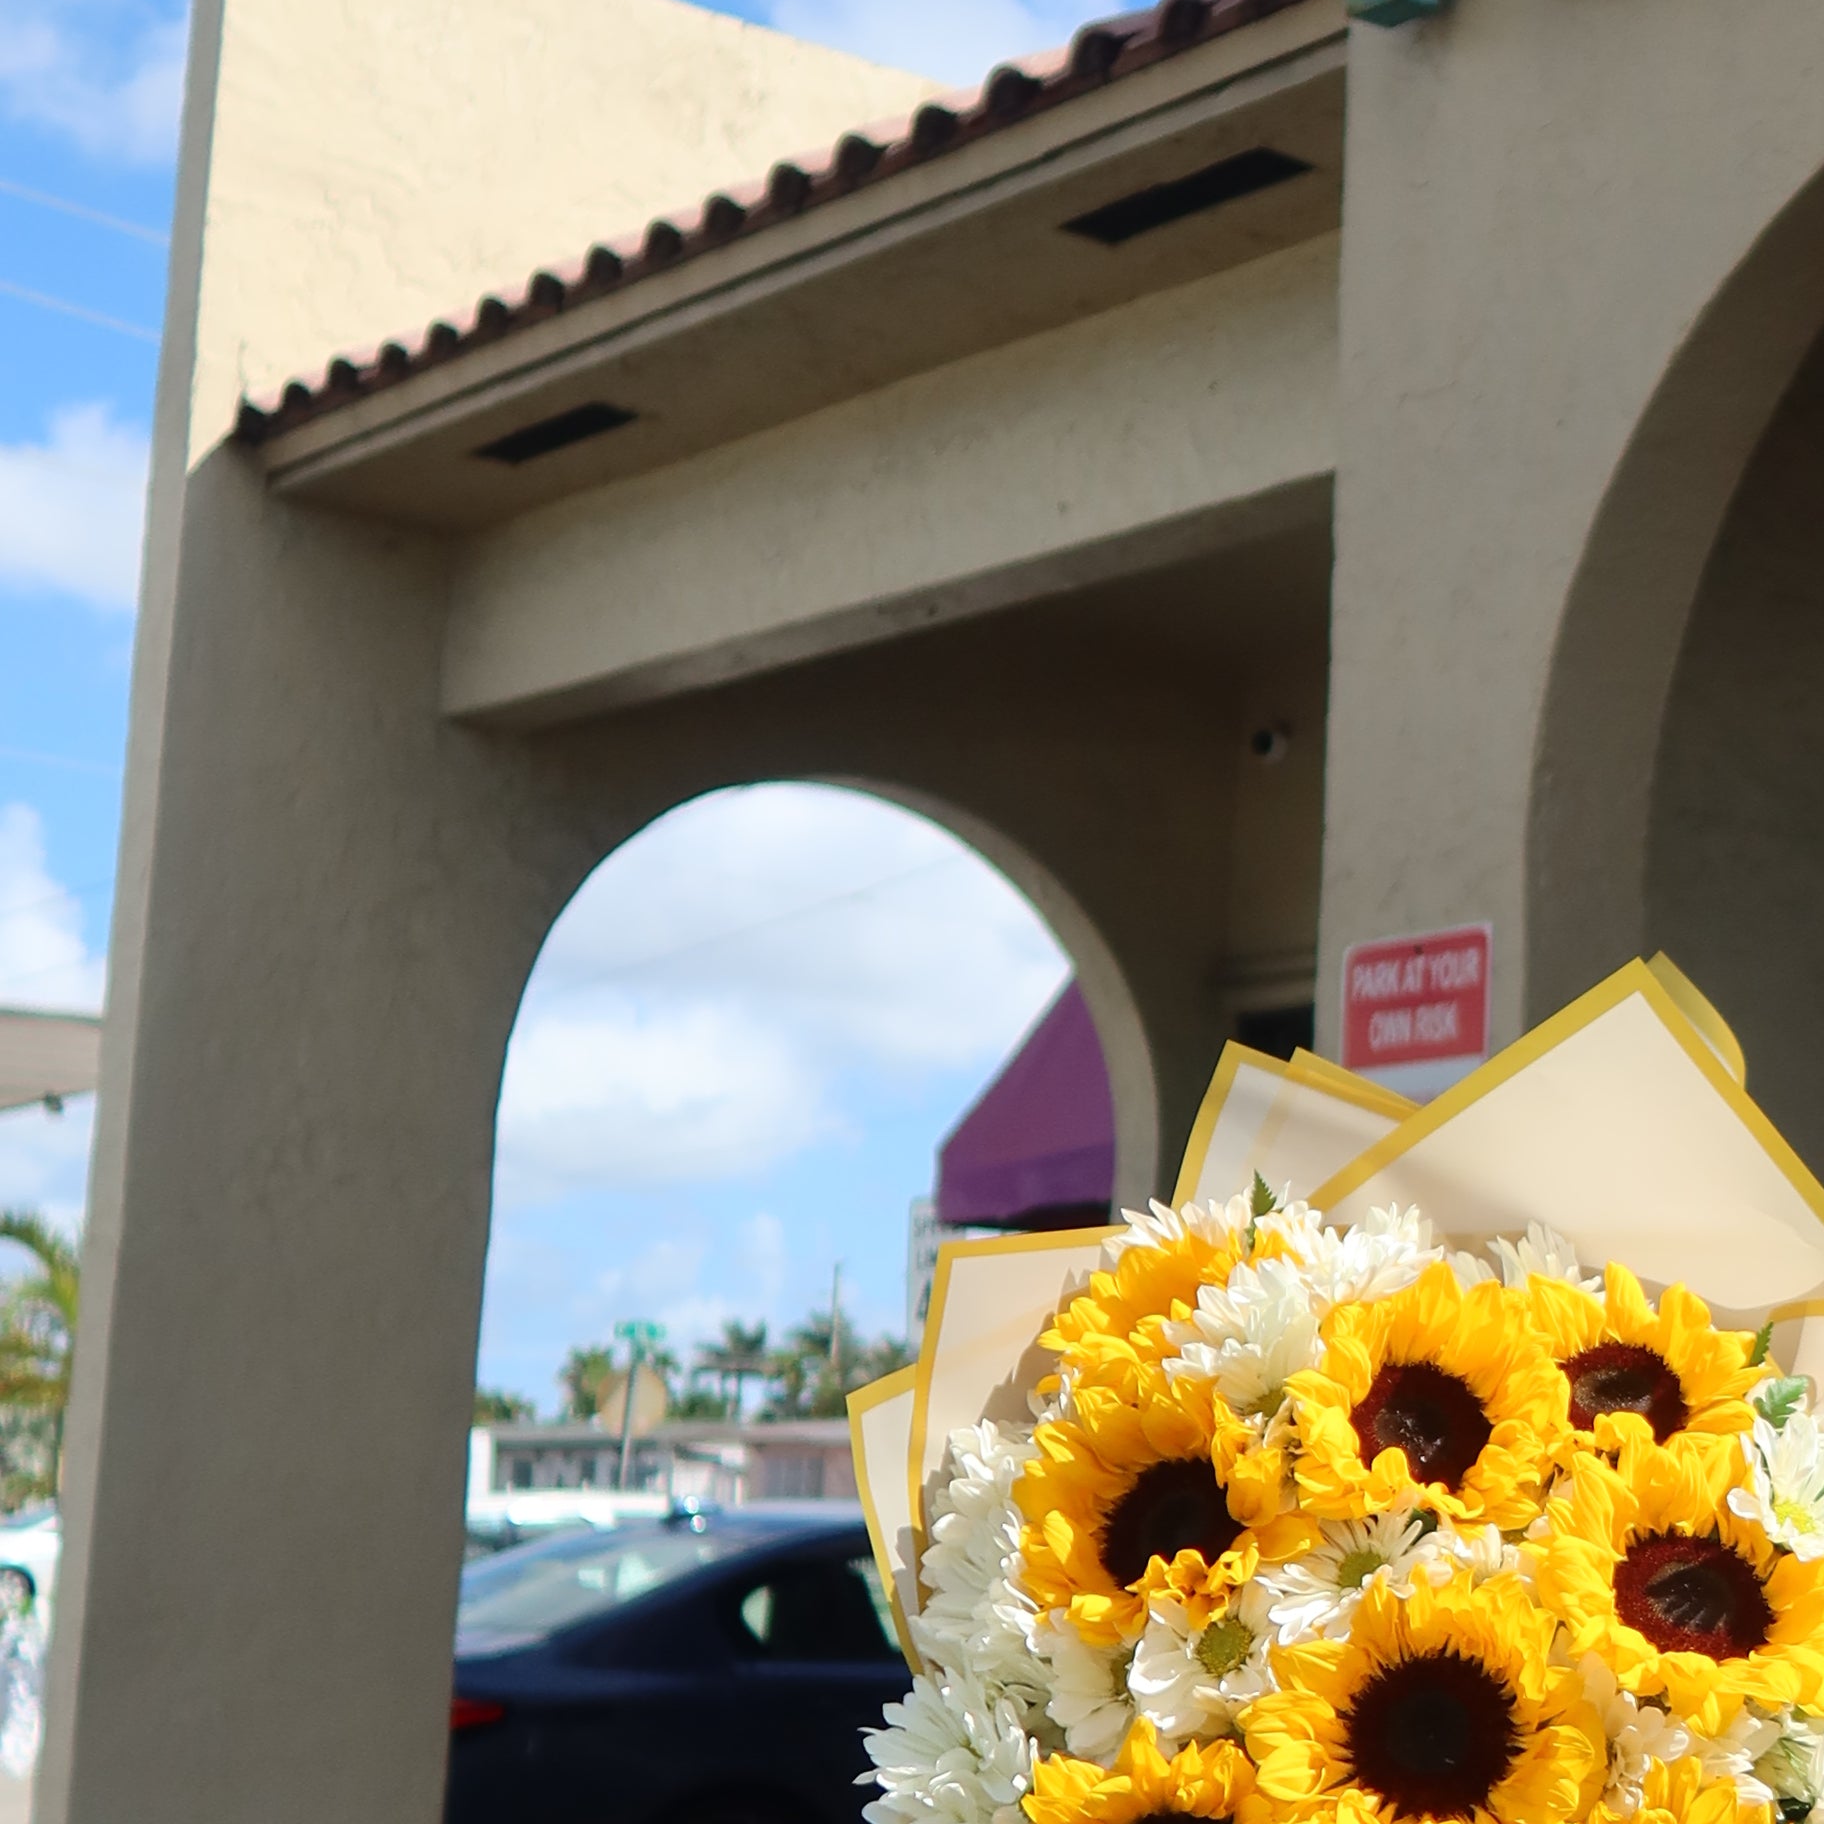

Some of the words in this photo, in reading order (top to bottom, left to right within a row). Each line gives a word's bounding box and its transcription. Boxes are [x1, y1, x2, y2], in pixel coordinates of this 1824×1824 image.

[1353, 960, 1399, 1000] PARK
[1402, 955, 1424, 993] AT
[1429, 947, 1479, 991] YOUR
[1369, 1007, 1411, 1052] OWN
[1414, 1000, 1457, 1043] RISK
